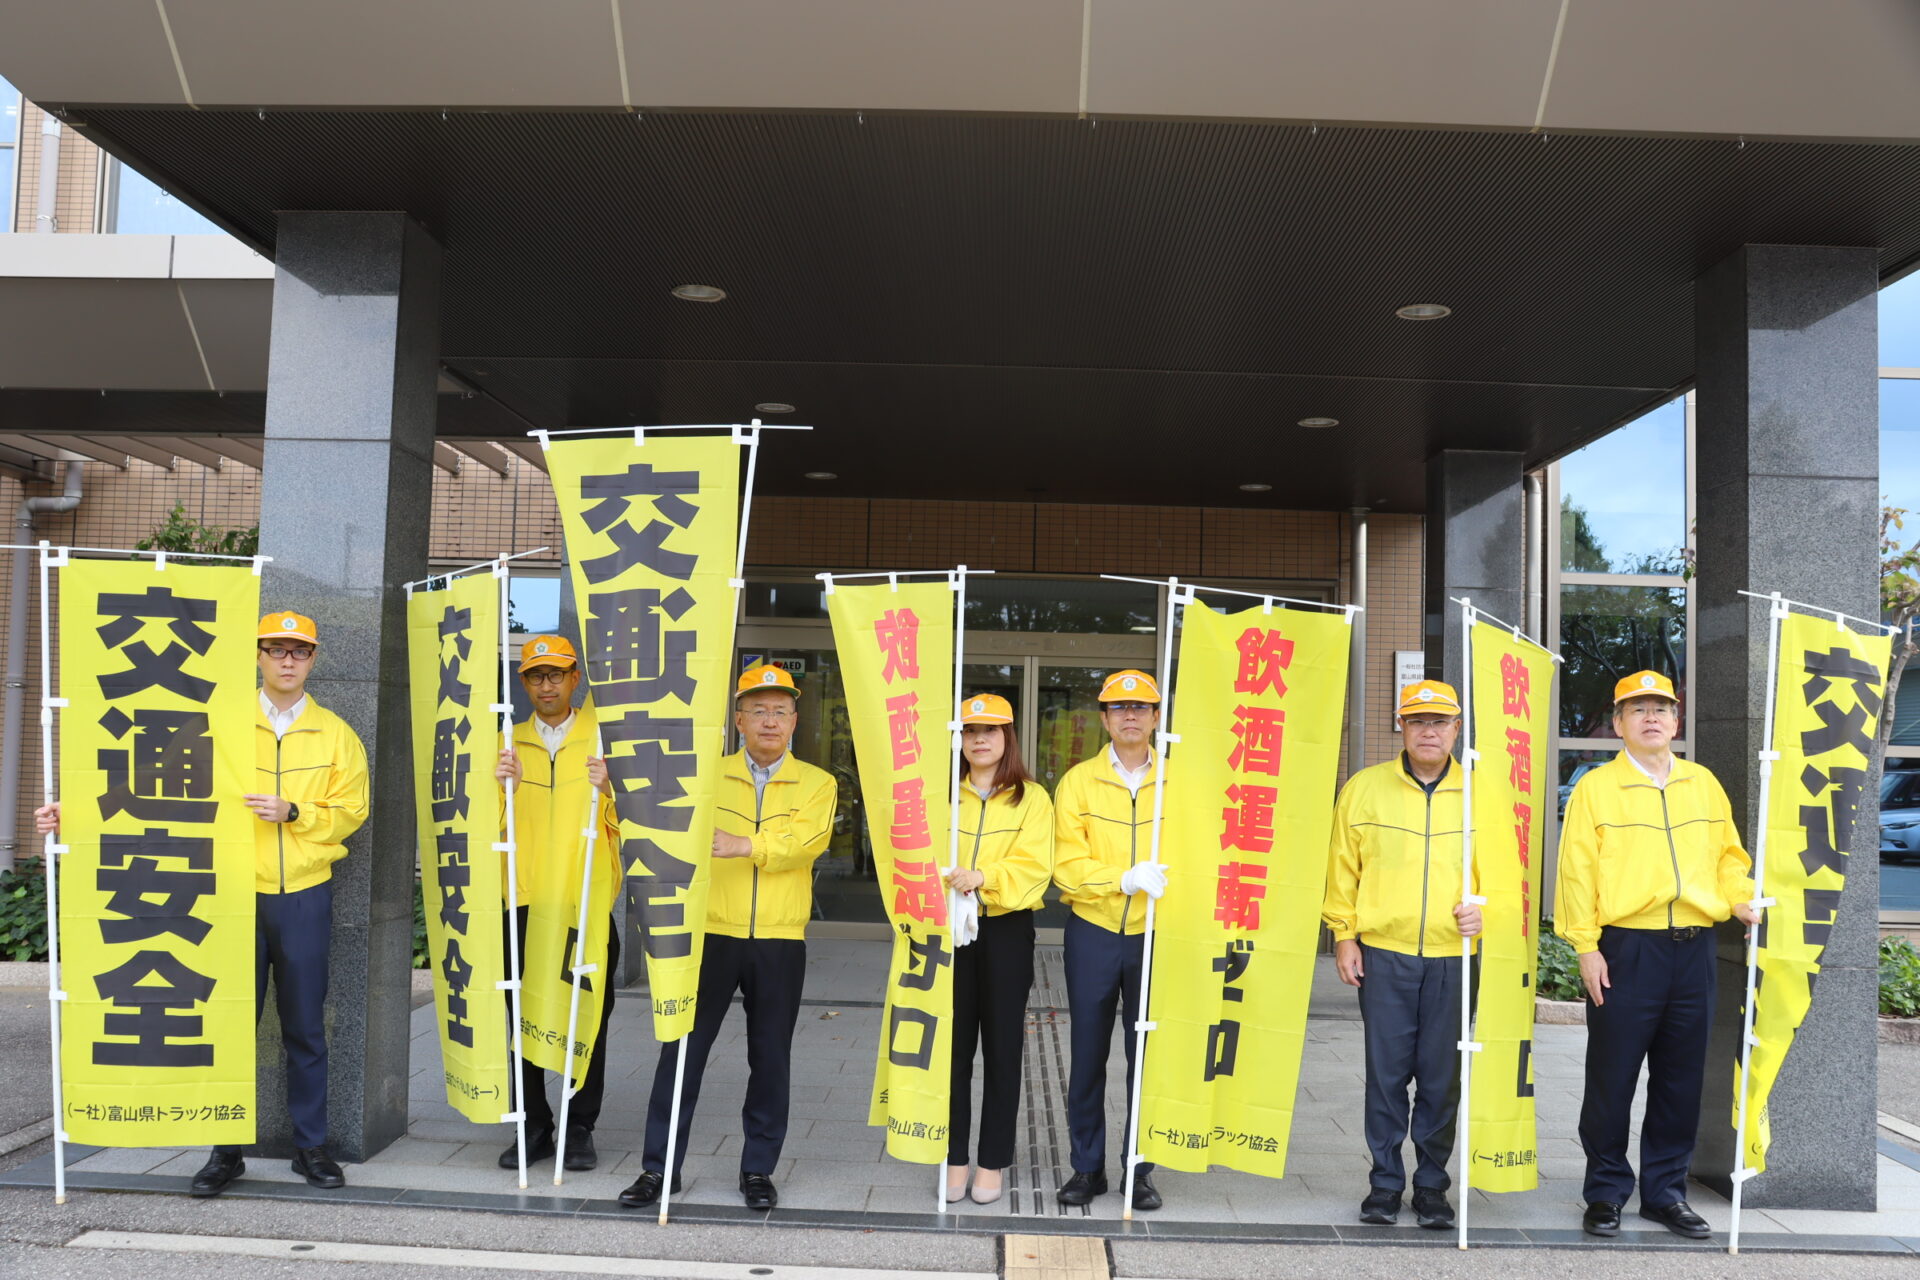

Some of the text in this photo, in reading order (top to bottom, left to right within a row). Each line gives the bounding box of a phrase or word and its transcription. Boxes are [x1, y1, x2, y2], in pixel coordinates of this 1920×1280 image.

[782, 661, 802, 670] AED
[92, 586, 219, 1068] 交通安全
[1204, 627, 1296, 1083] 飲酒運転ゼロ
[67, 1102, 247, 1122] (一社)富山県トラック協会
[1148, 1123, 1279, 1154] (一社)富山ラック協会
